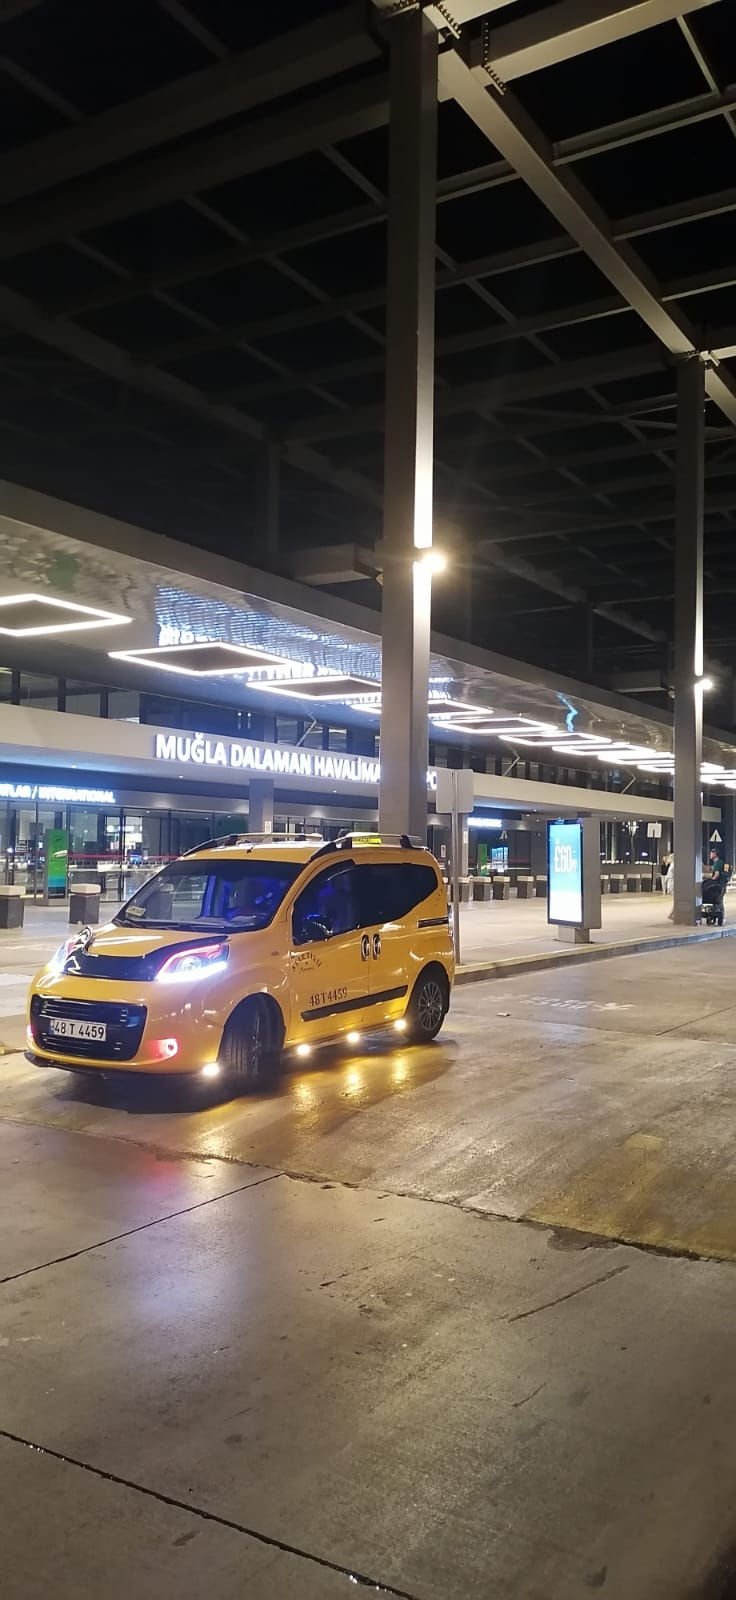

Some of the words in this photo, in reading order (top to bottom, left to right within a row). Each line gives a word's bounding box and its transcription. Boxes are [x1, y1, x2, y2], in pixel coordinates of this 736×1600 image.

[156, 732, 227, 765] MUĞLA
[231, 743, 311, 775] DALAMAN
[314, 755, 381, 783] HAVALİMA
[38, 786, 116, 803] INTERNATIONAL
[54, 1021, 66, 1034] 48
[69, 1023, 75, 1035] T
[78, 1025, 105, 1039] 4459
